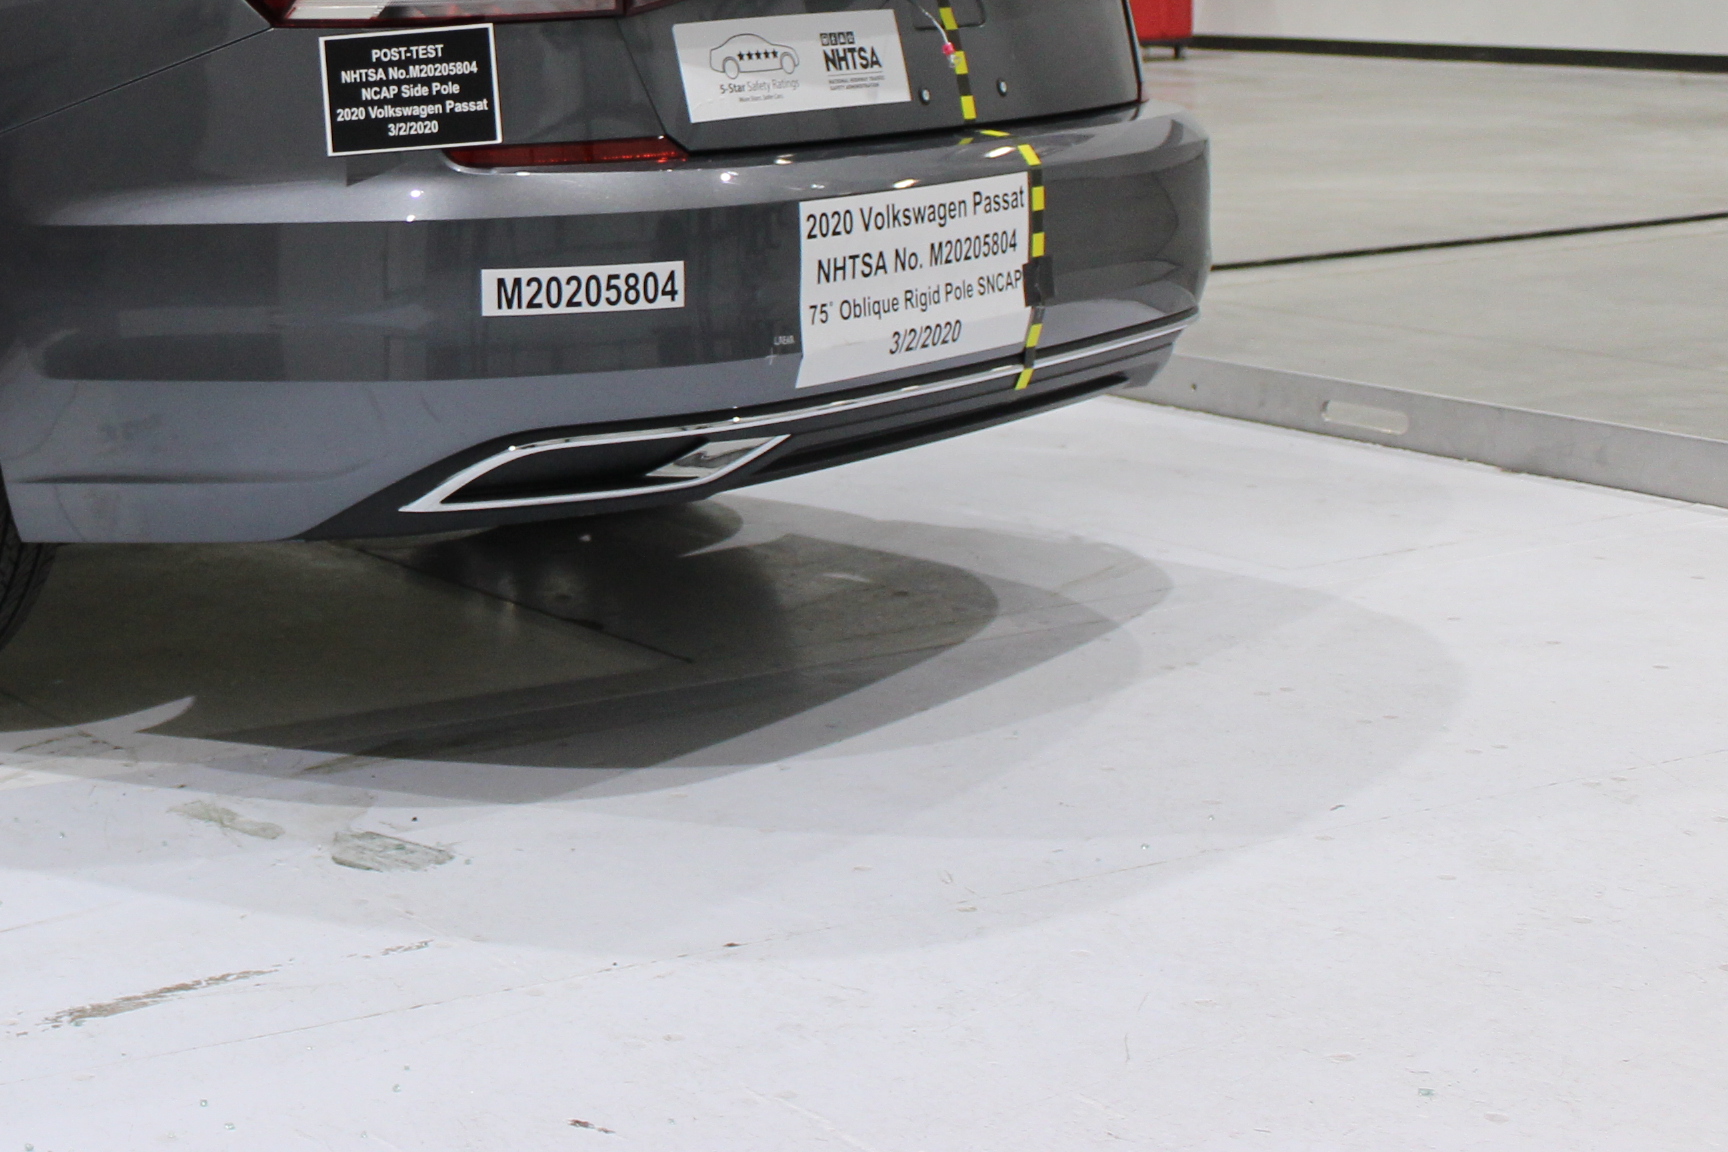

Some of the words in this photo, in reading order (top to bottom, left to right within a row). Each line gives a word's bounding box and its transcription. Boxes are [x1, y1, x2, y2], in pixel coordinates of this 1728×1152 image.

[371, 44, 444, 62] POST-TEST
[823, 46, 882, 72] NHTSA
[341, 67, 387, 84] NHTSA
[388, 61, 478, 80] No.M20205804
[361, 86, 398, 101] NCAP
[401, 84, 429, 98] Side
[432, 81, 460, 95] Pole
[719, 83, 745, 95] 5-Star
[746, 80, 771, 94] Safety
[772, 78, 800, 91] Ratings
[336, 107, 366, 122] 2020
[368, 101, 443, 119] Volkswagen
[445, 98, 489, 114] Passat
[387, 120, 439, 137] 3/2/2020
[806, 210, 854, 240] 2020
[860, 199, 968, 232] Volkswagen
[973, 186, 1025, 216] Passat
[817, 250, 888, 284] NHTSA
[894, 247, 924, 273] No.
[929, 229, 1018, 268] M20205804
[497, 269, 678, 310] M20205804
[839, 290, 900, 320] Oblique
[904, 285, 941, 312] Rigid
[945, 281, 974, 303] Pole
[977, 270, 1023, 296] SNCAP
[889, 319, 962, 355] 3/2/2020
